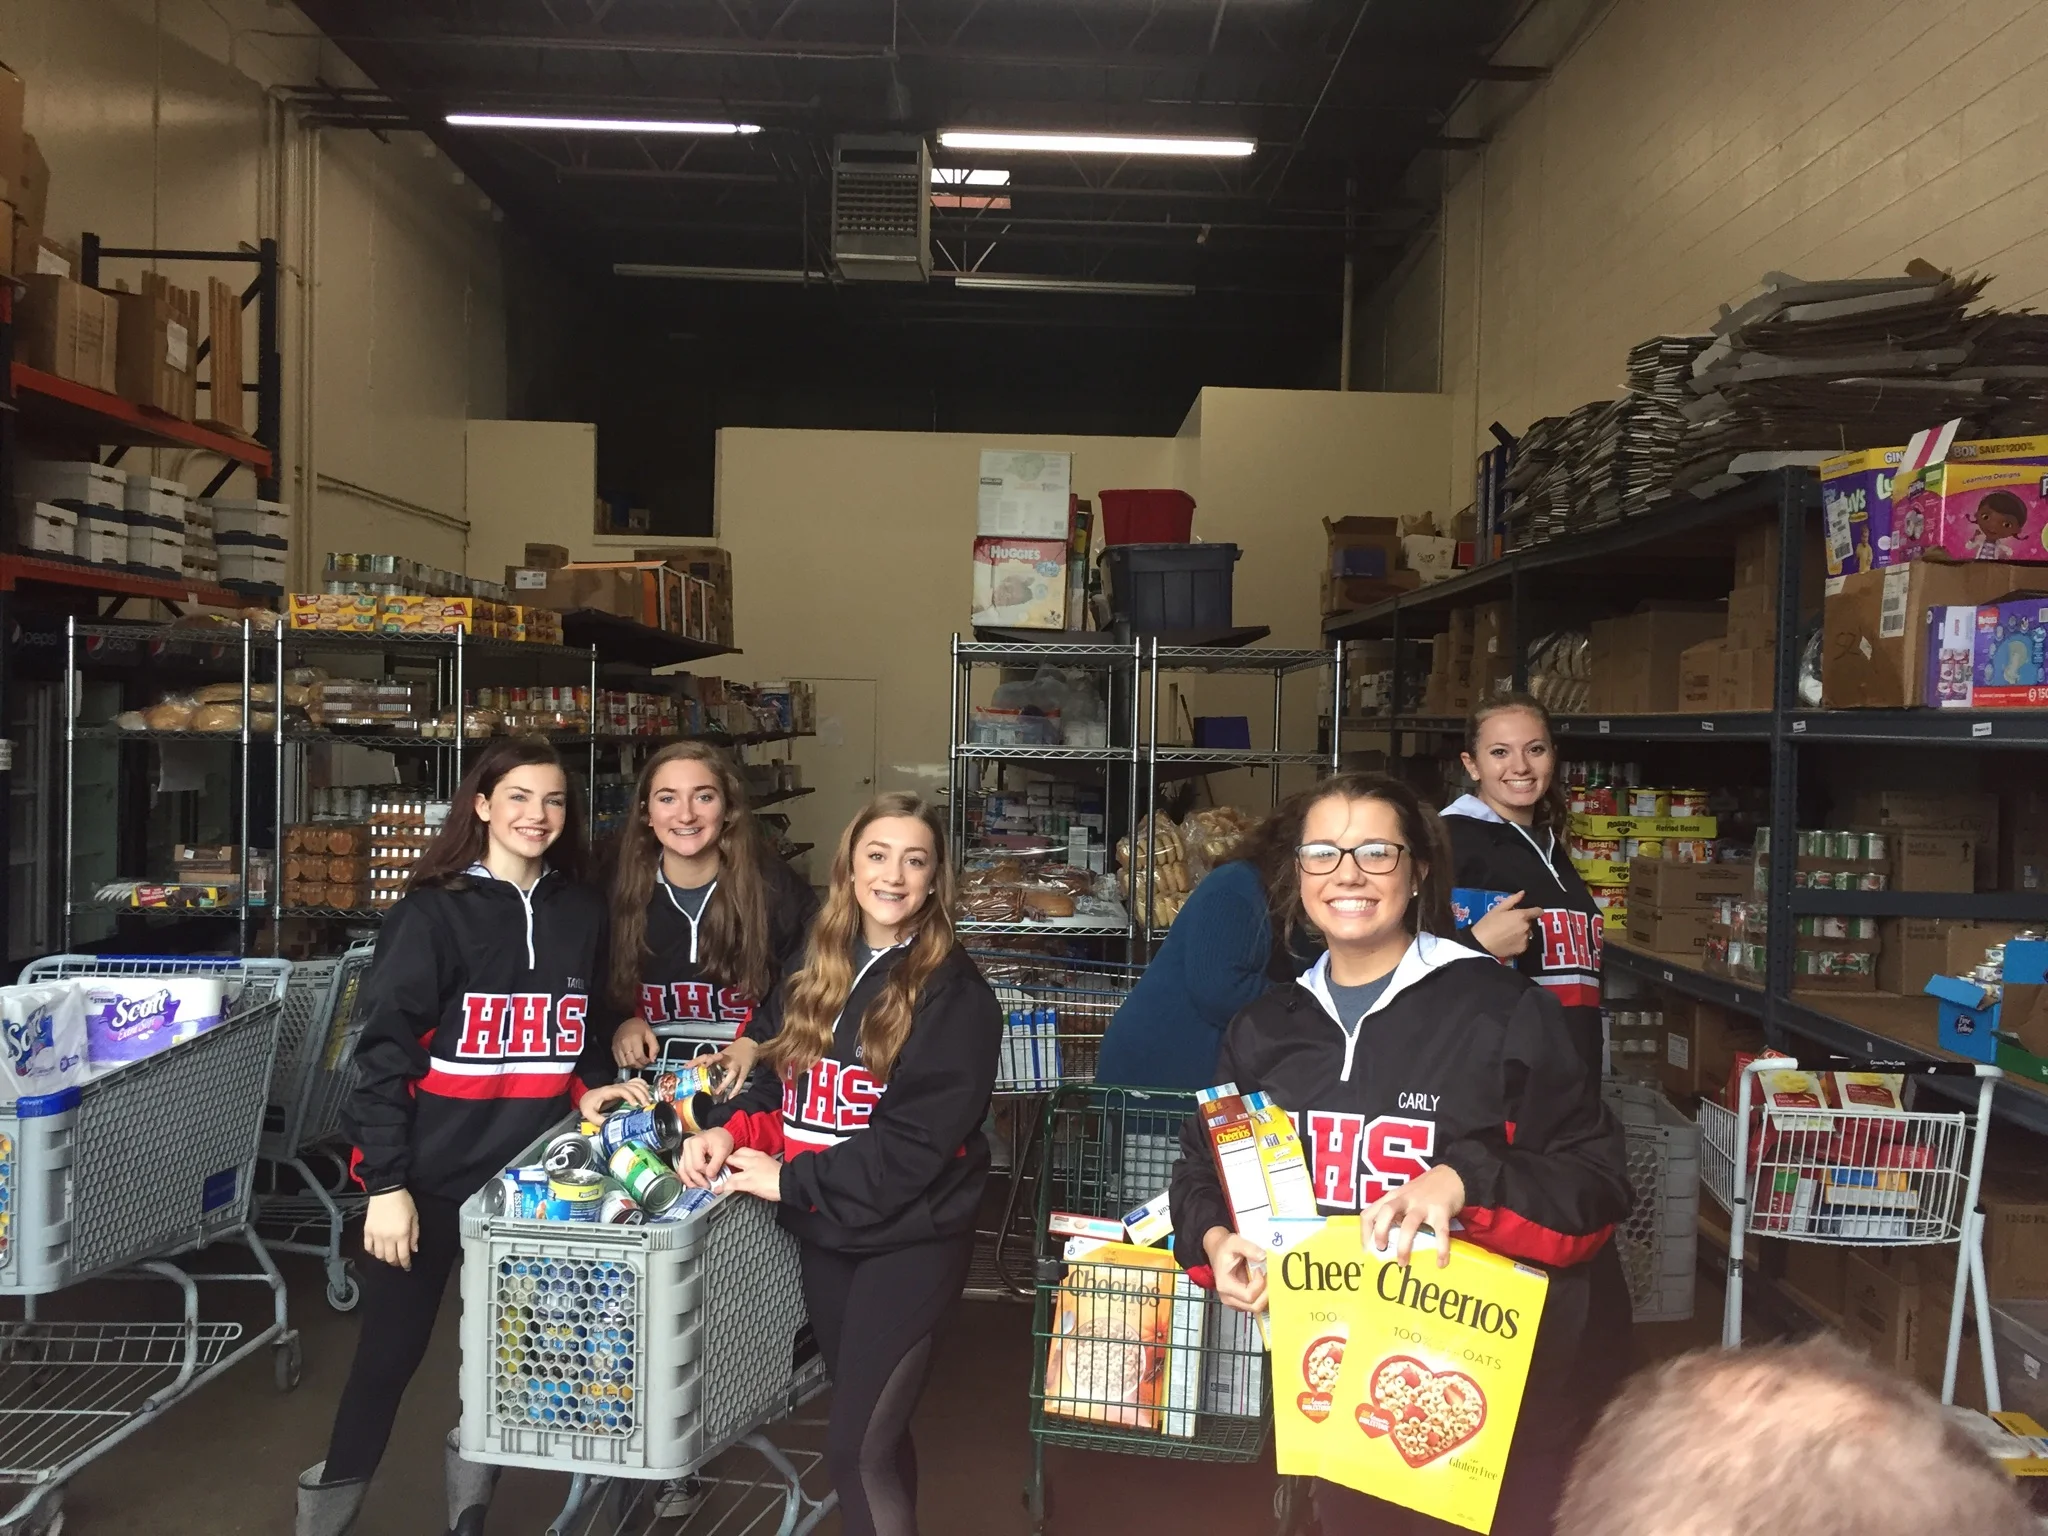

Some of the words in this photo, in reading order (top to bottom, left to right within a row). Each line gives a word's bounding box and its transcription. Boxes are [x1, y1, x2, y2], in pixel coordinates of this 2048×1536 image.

[1953, 445, 1977, 458] BOX
[1979, 444, 2000, 455] SAVE
[1962, 474, 1992, 485] Learning
[1993, 471, 2021, 481] Designs
[990, 545, 1041, 560] HUGGIES
[1607, 820, 1638, 830] Rosarita
[1656, 824, 1679, 833] Refried
[112, 989, 169, 1028] Scott
[456, 992, 588, 1058] HHS
[1398, 1092, 1441, 1111] CARLY
[1216, 1128, 1251, 1144] Cheerios
[1287, 1110, 1436, 1209] HS
[1281, 1251, 1364, 1292] Chee
[1068, 1269, 1161, 1308] Cheerios
[1376, 1260, 1520, 1340] Cheerios
[1463, 1349, 1502, 1371] OATS
[1449, 1456, 1479, 1475] Gluten
[1480, 1465, 1498, 1482] Free
